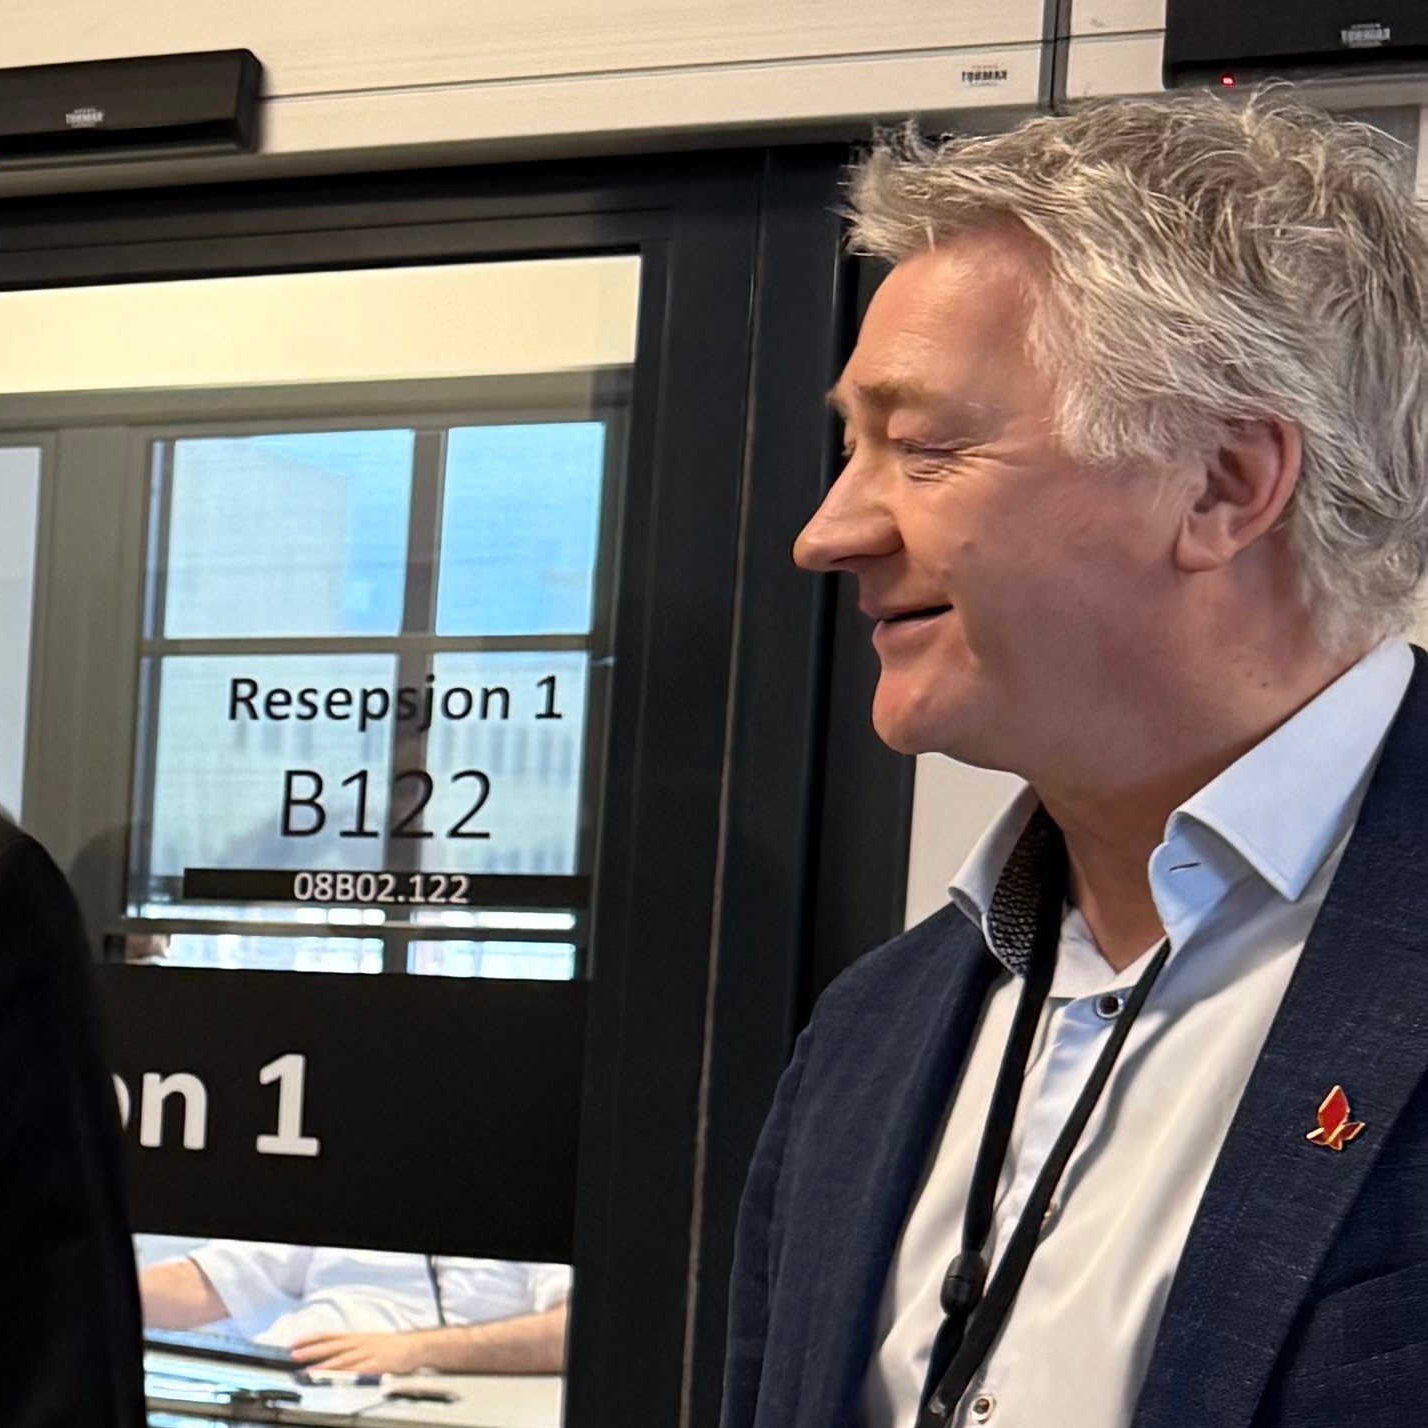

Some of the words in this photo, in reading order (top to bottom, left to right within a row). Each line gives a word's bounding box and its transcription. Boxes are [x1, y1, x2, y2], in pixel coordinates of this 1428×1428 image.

[228, 675, 512, 733] Resepsjon
[534, 674, 564, 721] 1
[280, 768, 493, 841] B122
[293, 872, 471, 905] 08B02.122
[255, 1053, 321, 1157] 1
